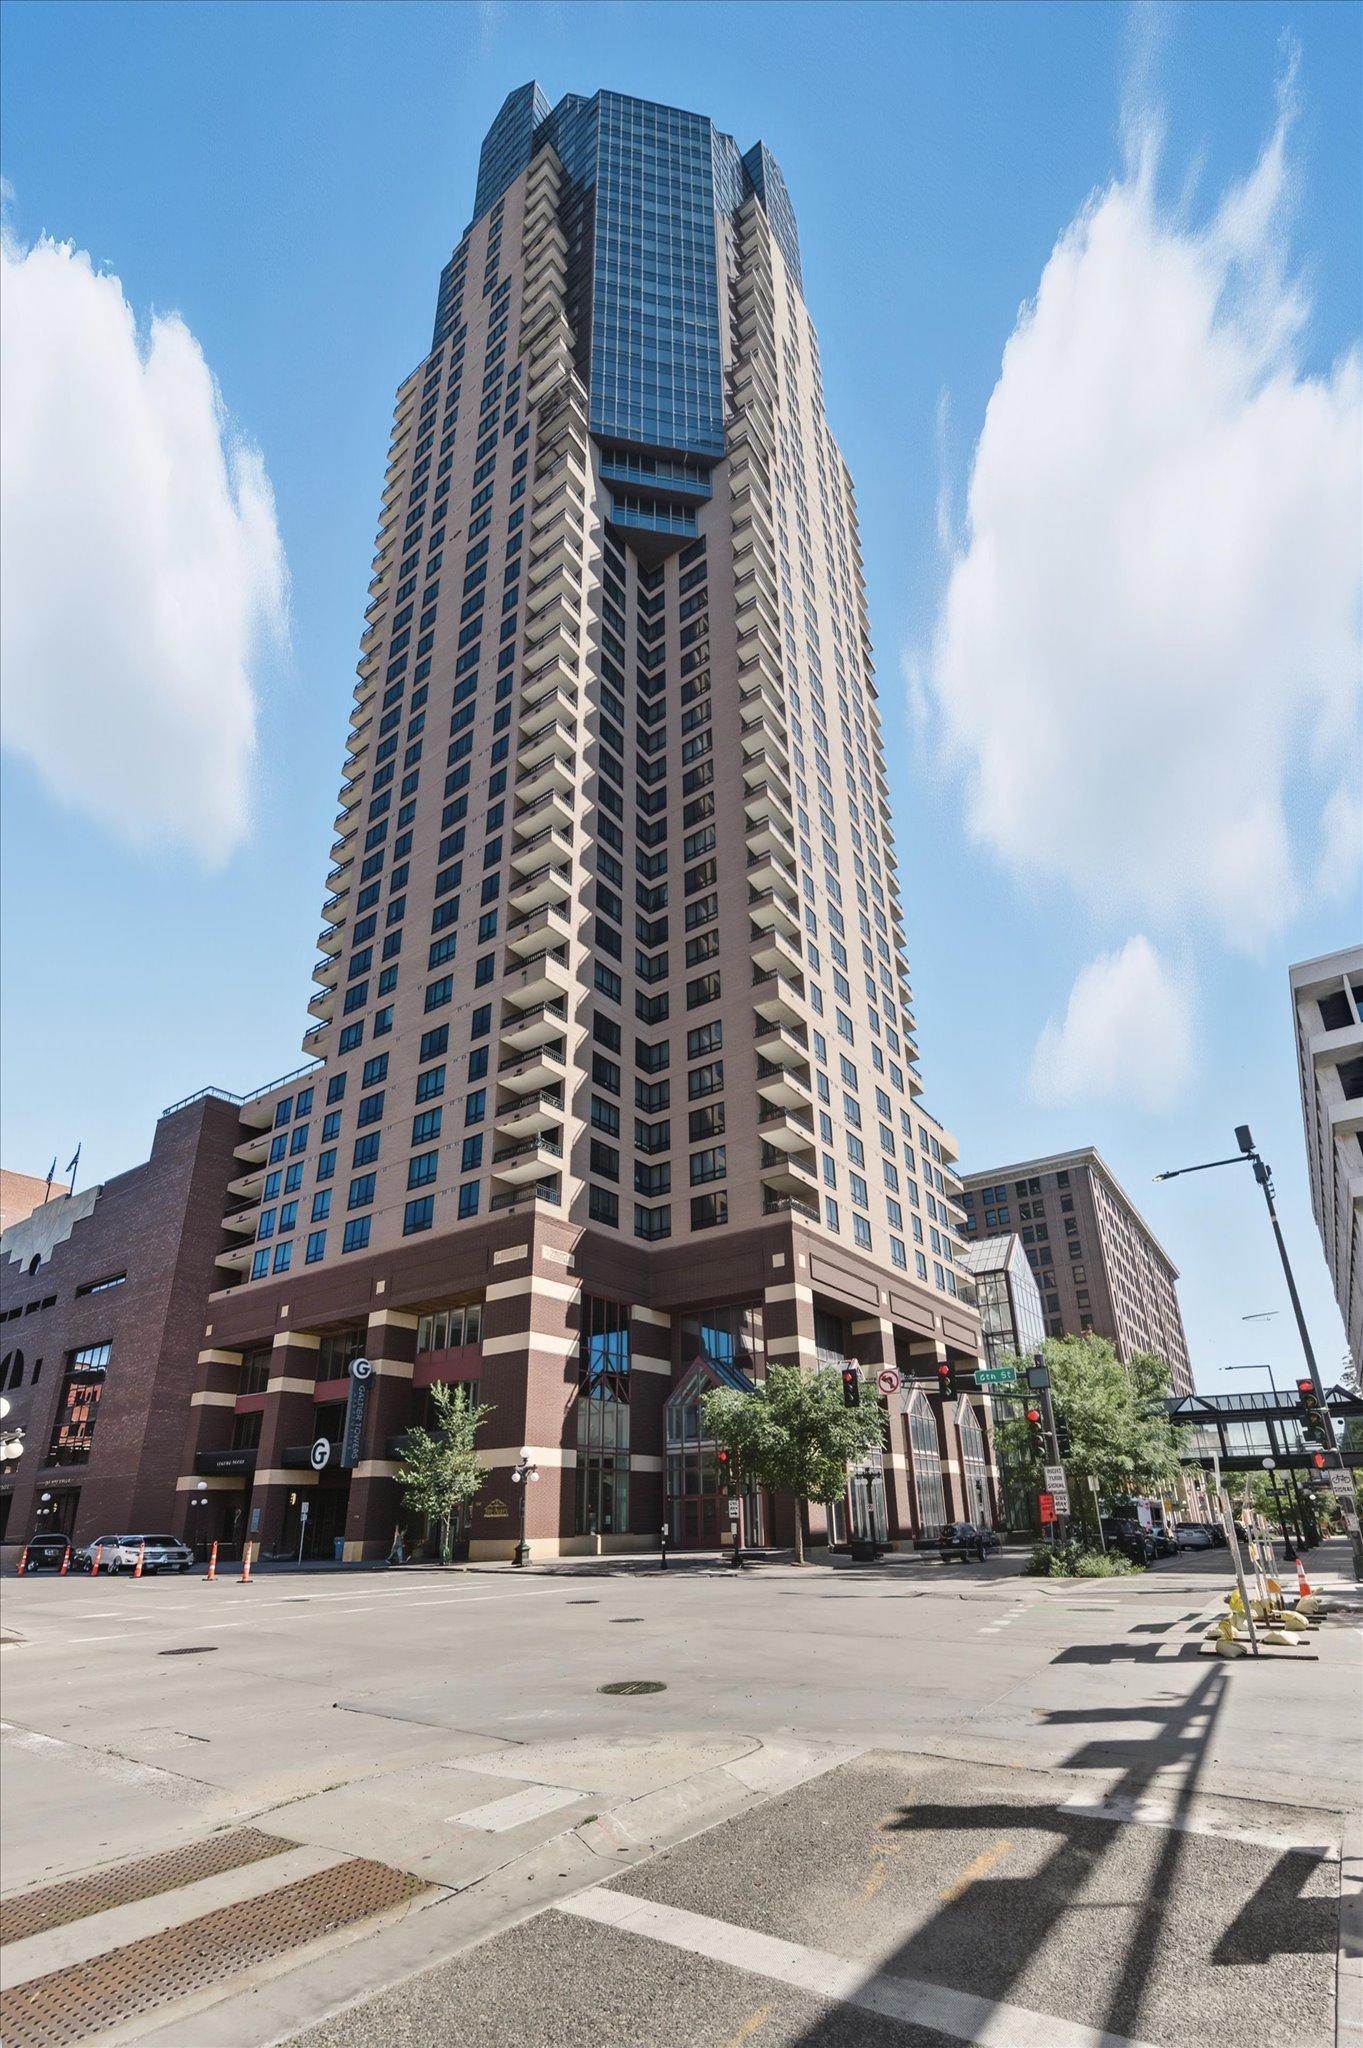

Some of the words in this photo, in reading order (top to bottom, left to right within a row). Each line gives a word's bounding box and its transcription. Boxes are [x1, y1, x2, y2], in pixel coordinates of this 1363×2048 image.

[357, 1361, 370, 1375] G
[1000, 1371, 1011, 1379] St
[351, 1422, 362, 1459] TOWERS
[312, 1442, 327, 1464] G
